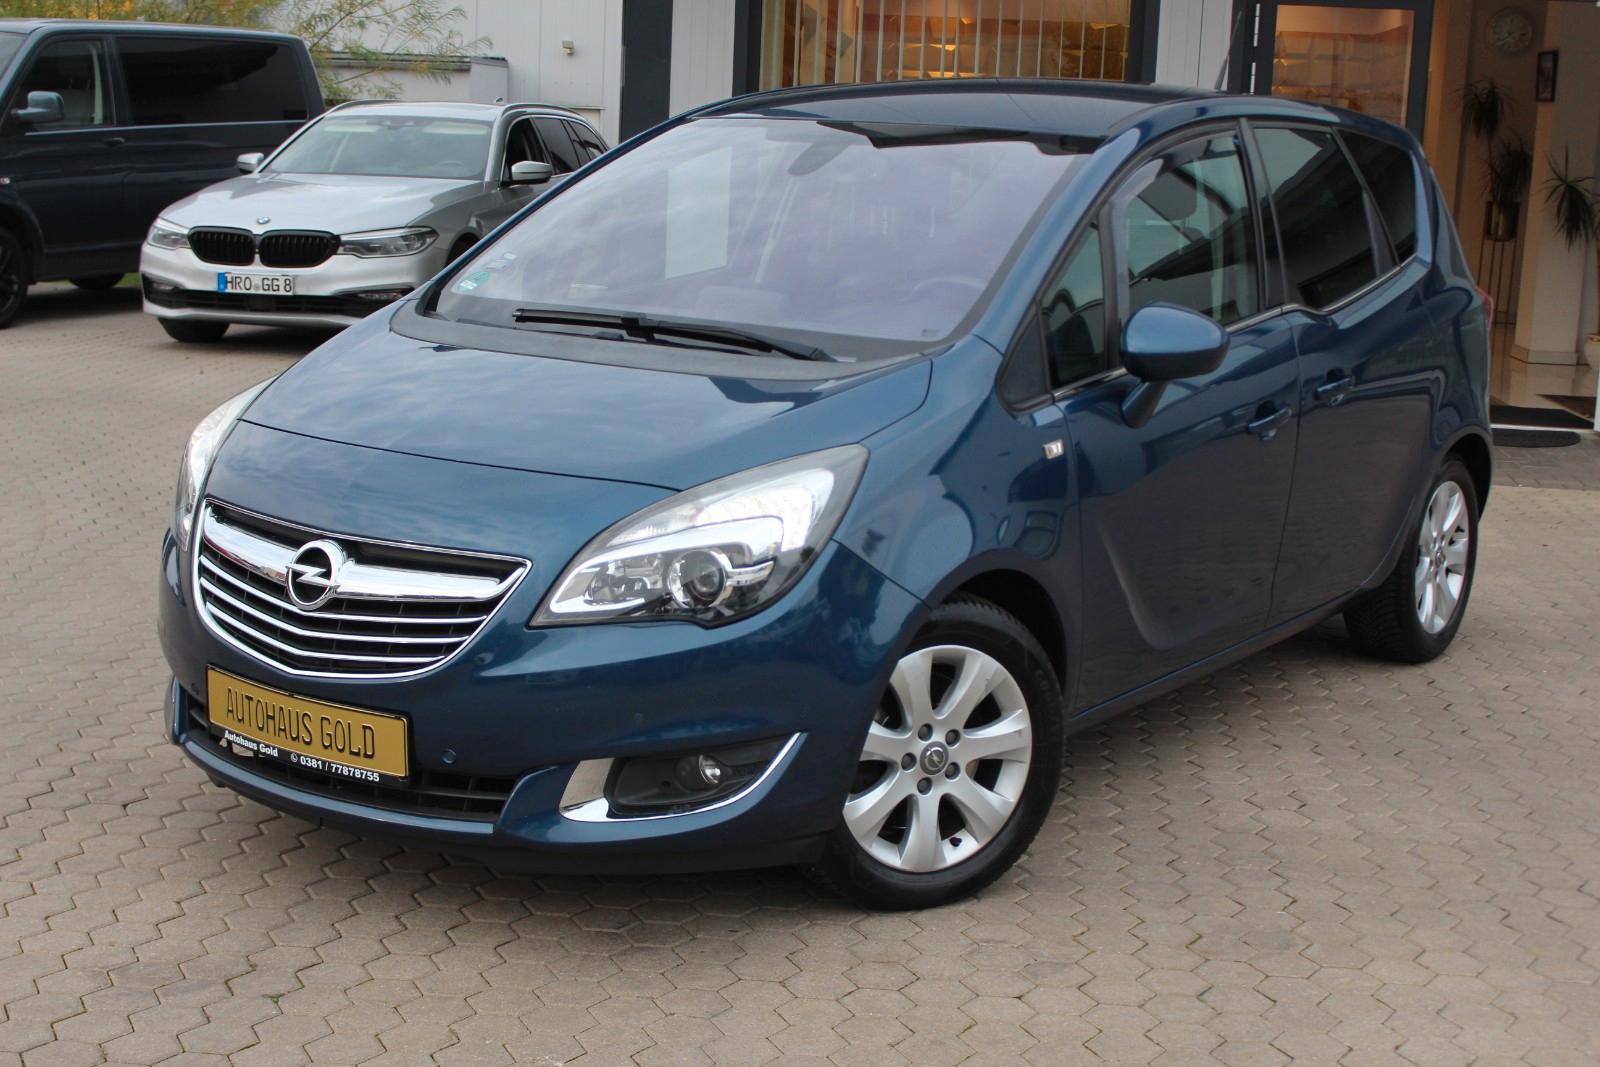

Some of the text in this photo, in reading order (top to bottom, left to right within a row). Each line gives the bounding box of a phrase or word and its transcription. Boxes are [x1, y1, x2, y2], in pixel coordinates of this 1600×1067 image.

[226, 276, 292, 293] HRO GG 8
[226, 687, 376, 759] AUTOHAUS GOLD
[224, 730, 279, 757] Autohaus Gold
[300, 756, 323, 770] 0381
[331, 763, 380, 782] 77878755
